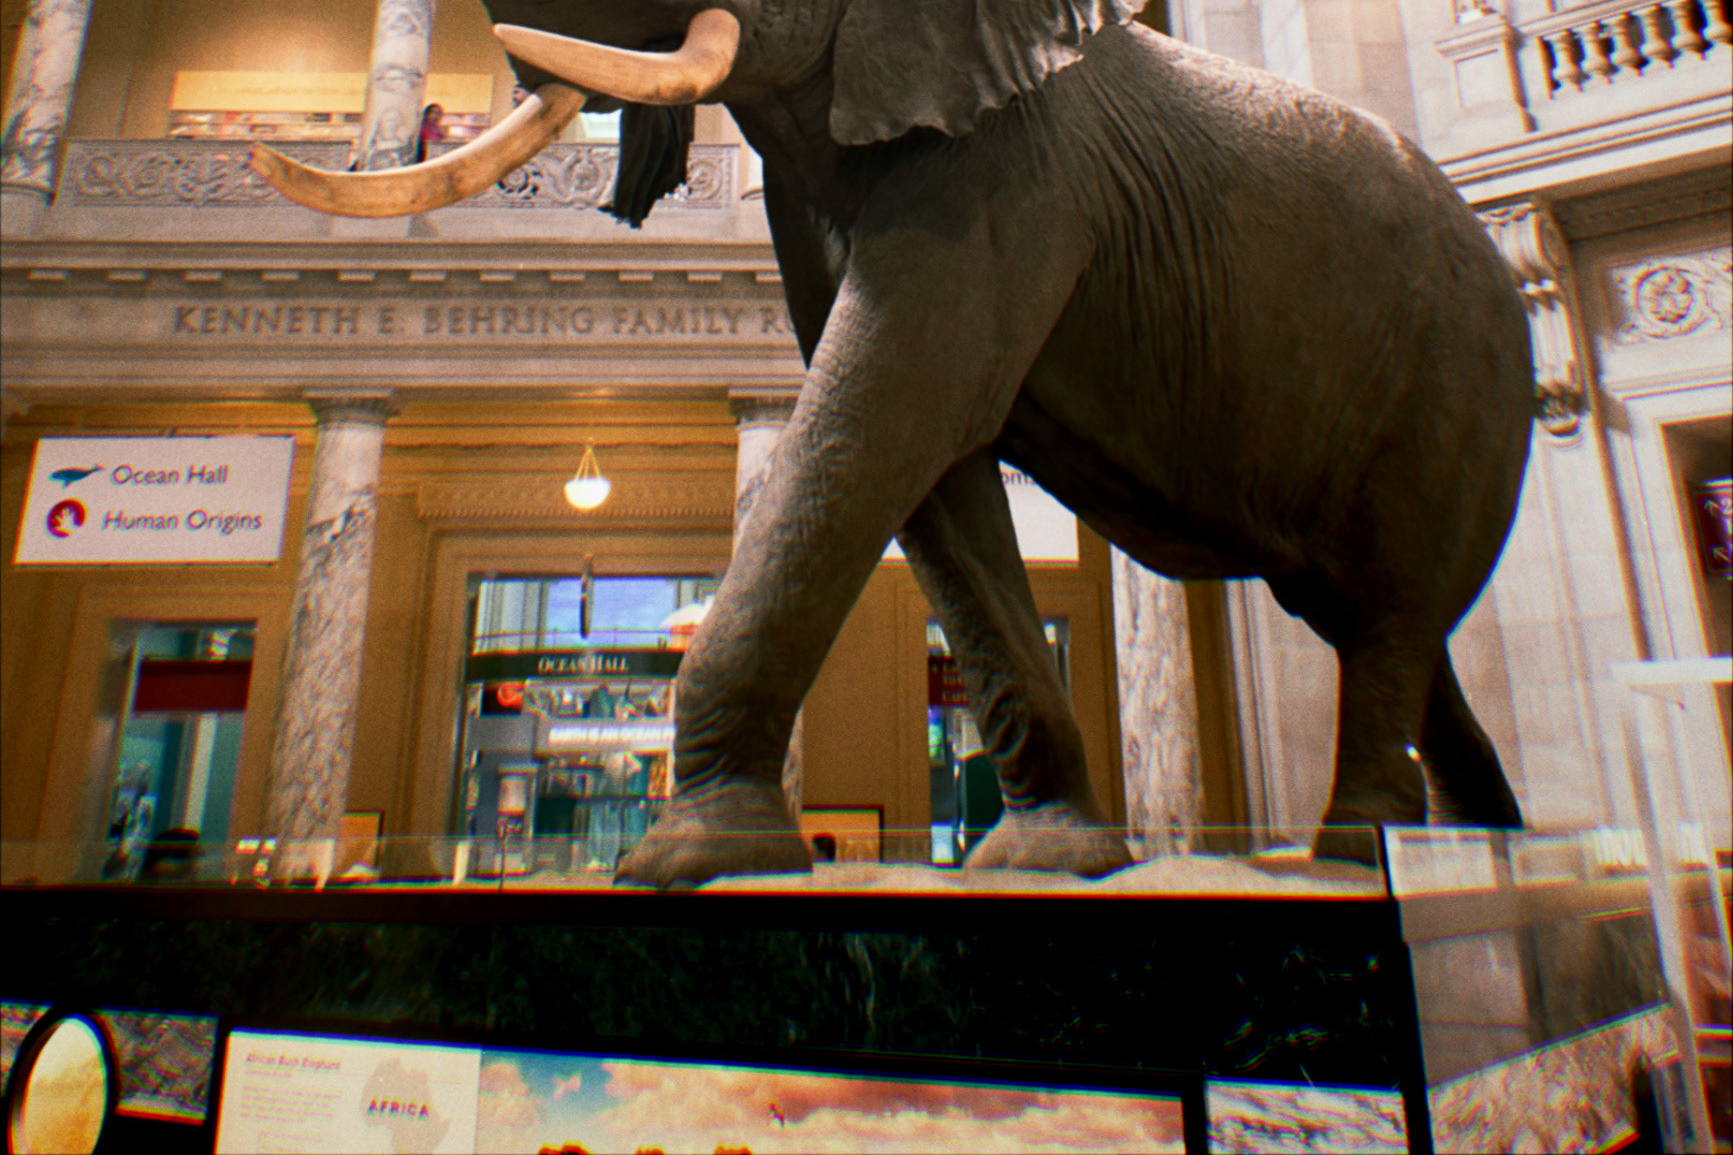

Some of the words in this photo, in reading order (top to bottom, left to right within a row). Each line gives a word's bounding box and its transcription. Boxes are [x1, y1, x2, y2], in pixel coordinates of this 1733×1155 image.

[172, 305, 361, 334] KENNETH
[376, 305, 406, 334] E.
[422, 305, 594, 334] BEHRING
[612, 306, 744, 334] FAMILY
[110, 463, 182, 486] Ocean
[185, 462, 230, 486] Hall
[101, 508, 181, 531] Human
[184, 507, 264, 536] Origins
[590, 652, 630, 673] HALL
[367, 1096, 430, 1120] AFRICA
